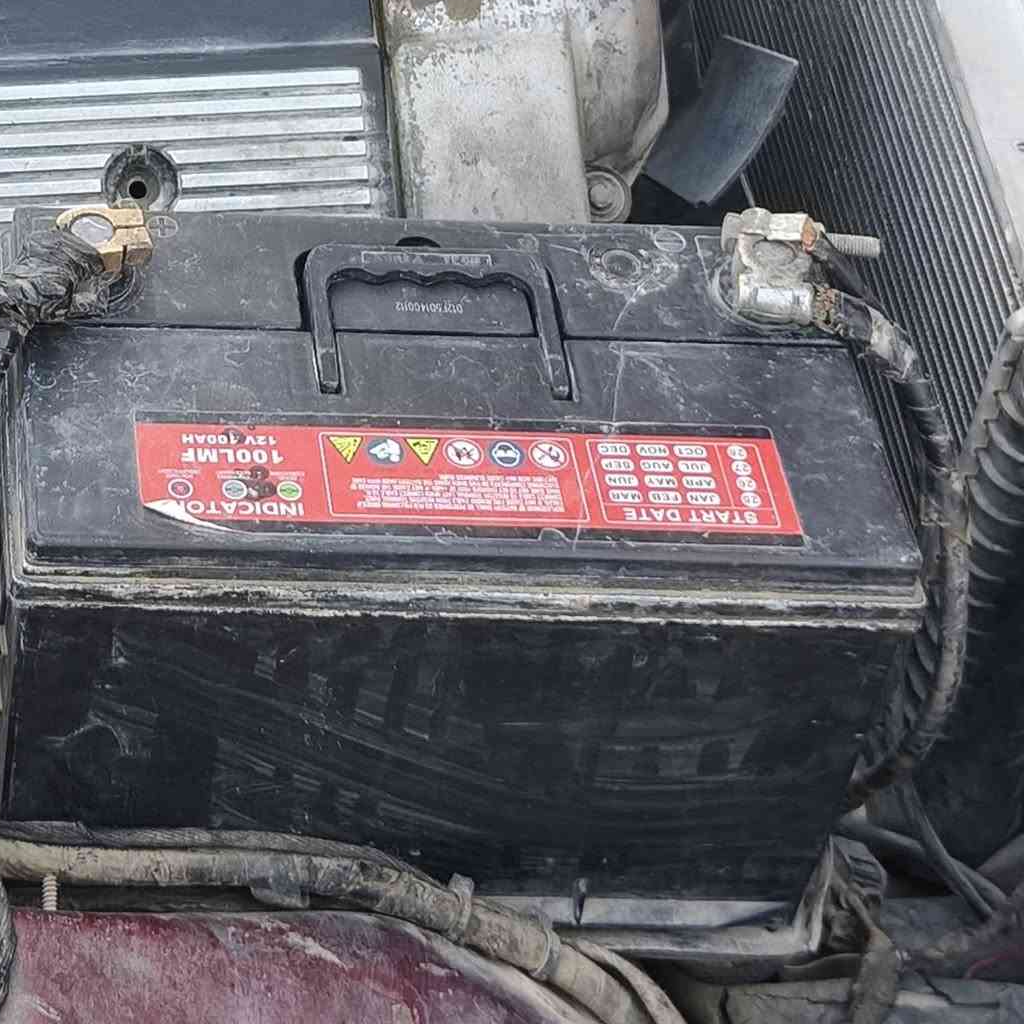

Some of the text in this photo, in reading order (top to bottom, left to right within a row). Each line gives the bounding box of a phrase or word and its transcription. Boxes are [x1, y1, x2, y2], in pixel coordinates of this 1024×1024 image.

[182, 433, 277, 445] 12V 100AH
[180, 447, 284, 464] 100LMF
[600, 445, 704, 455] OCT NOV DEC
[604, 461, 708, 471] JUL AUG SEP
[607, 476, 713, 487] APR MAY JUN
[611, 492, 718, 503] JAN FEB MAR
[622, 507, 758, 524] START DATE
